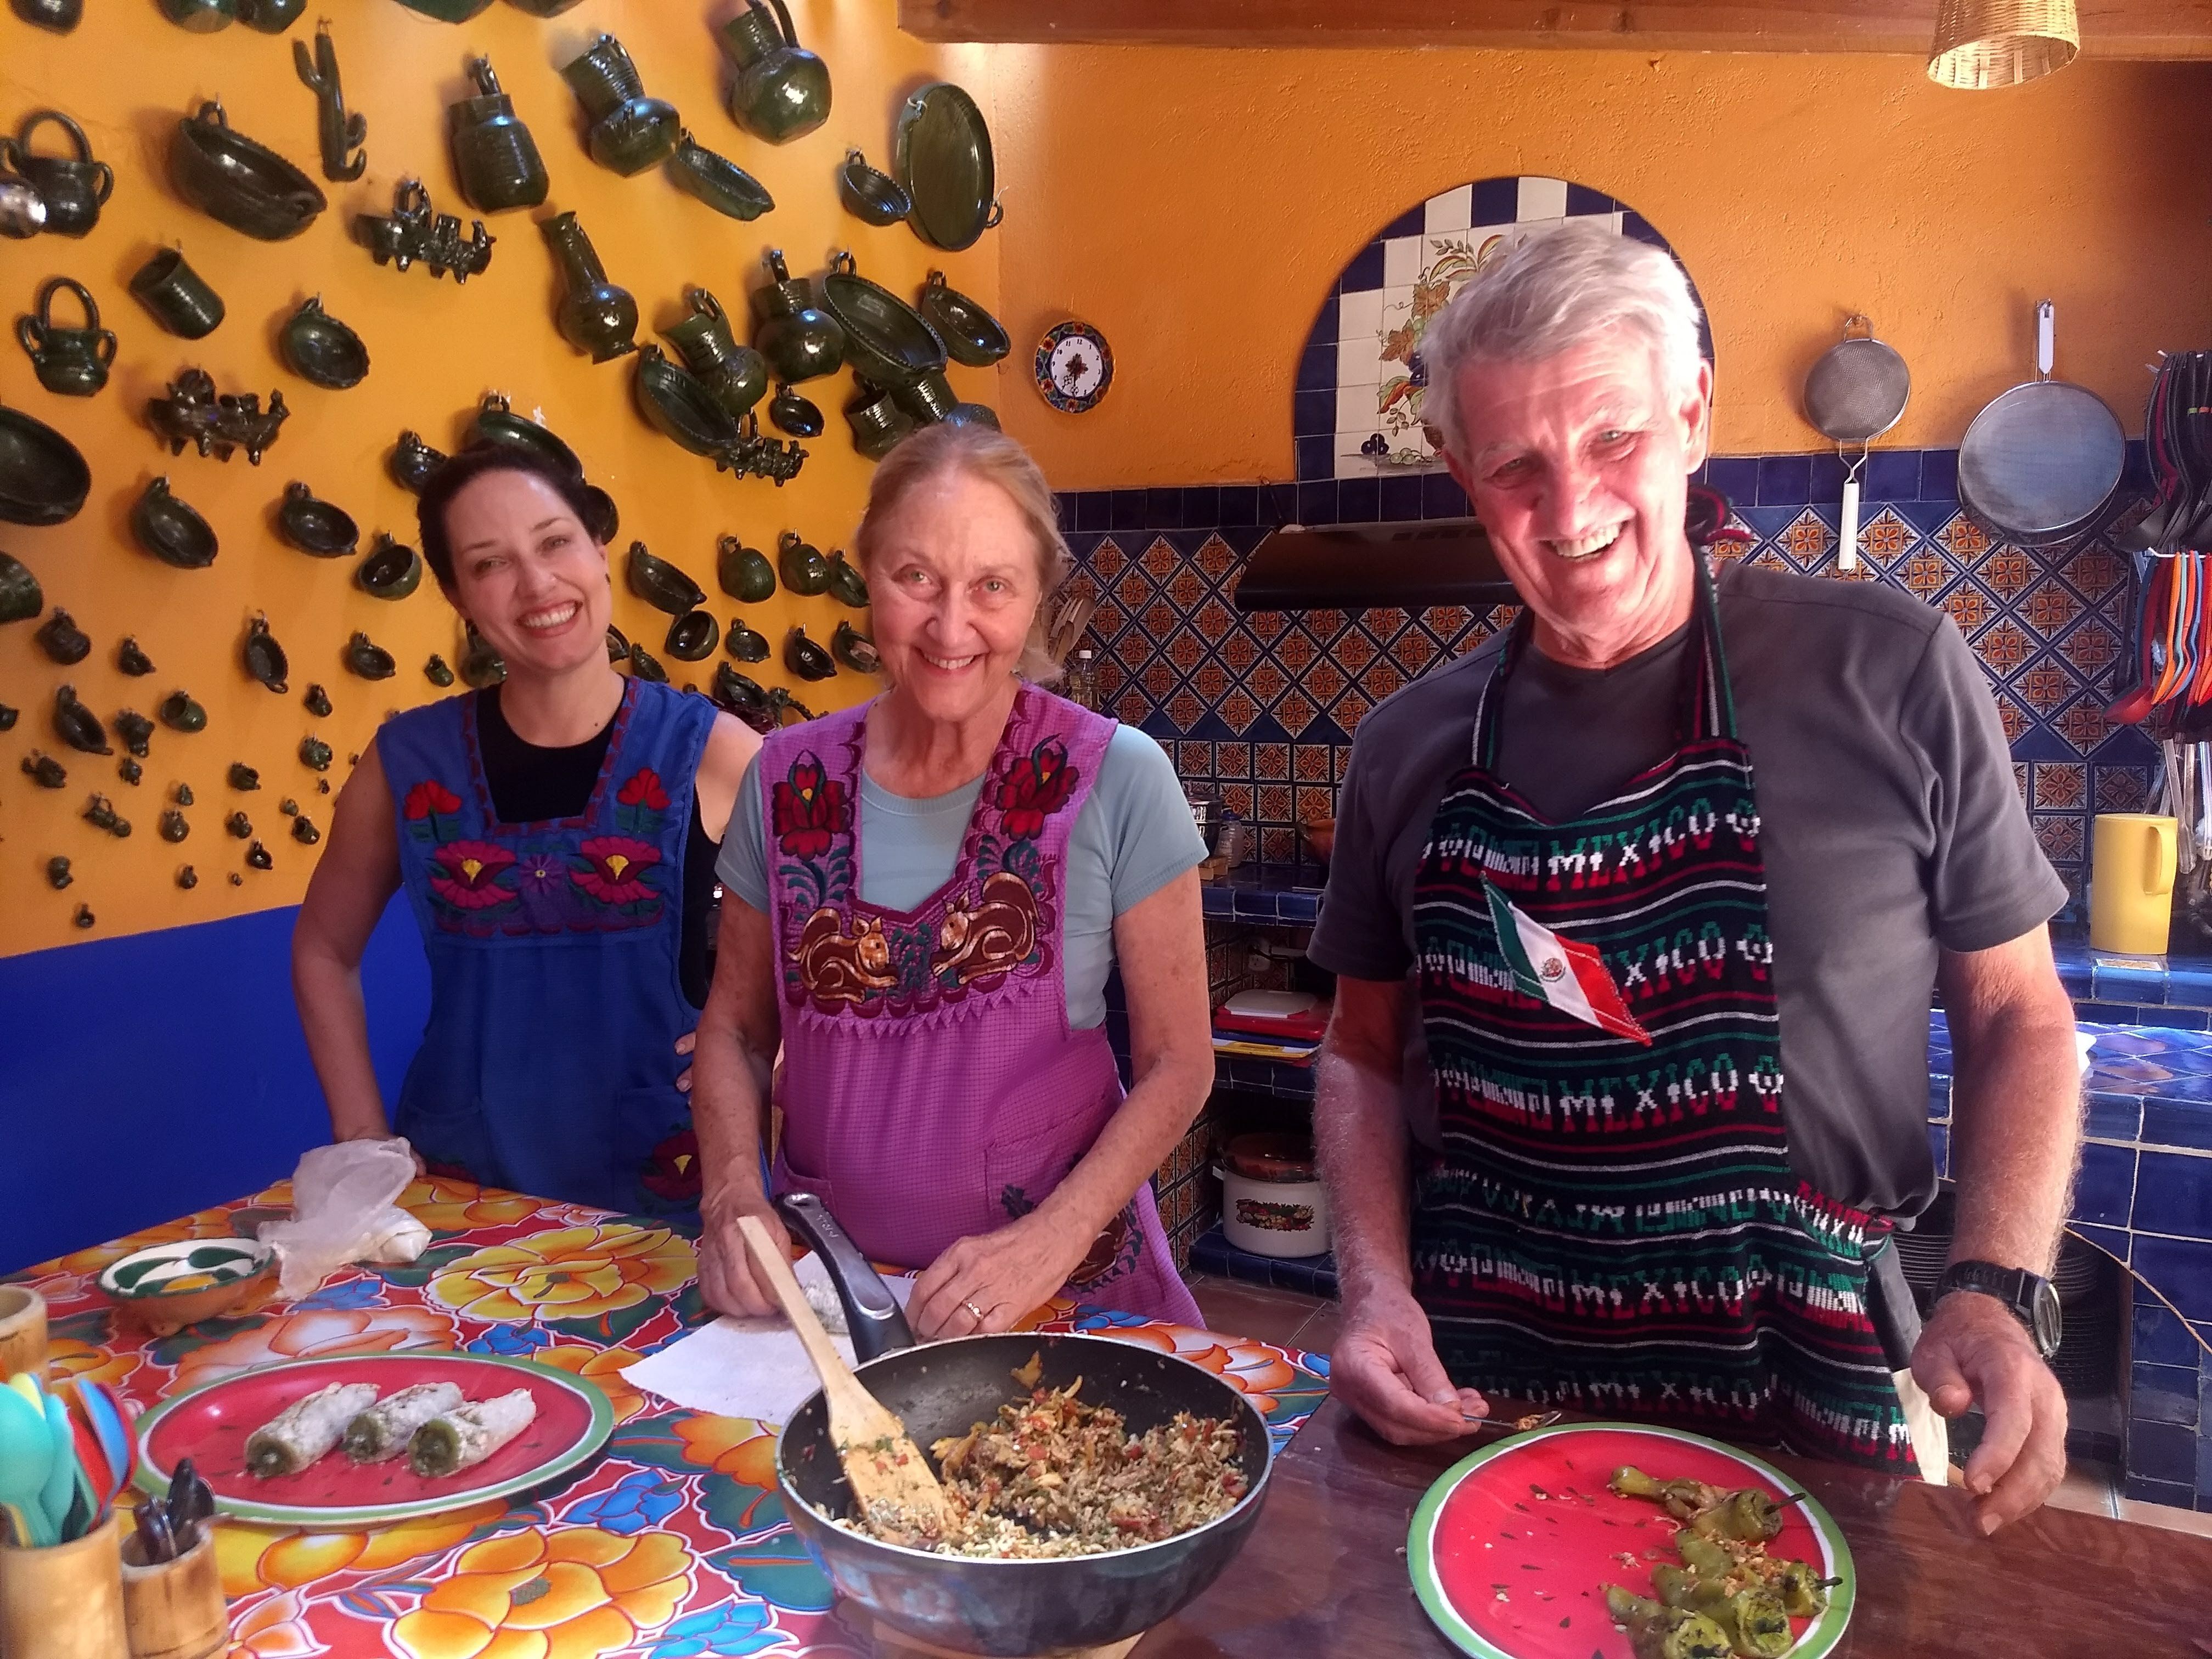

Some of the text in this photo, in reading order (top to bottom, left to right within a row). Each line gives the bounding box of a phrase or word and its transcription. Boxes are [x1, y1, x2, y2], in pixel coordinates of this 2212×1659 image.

[1546, 797, 1718, 892] MEXICO
[1605, 921, 1727, 1004] XICO
[1558, 1053, 1740, 1132] MEXICO
